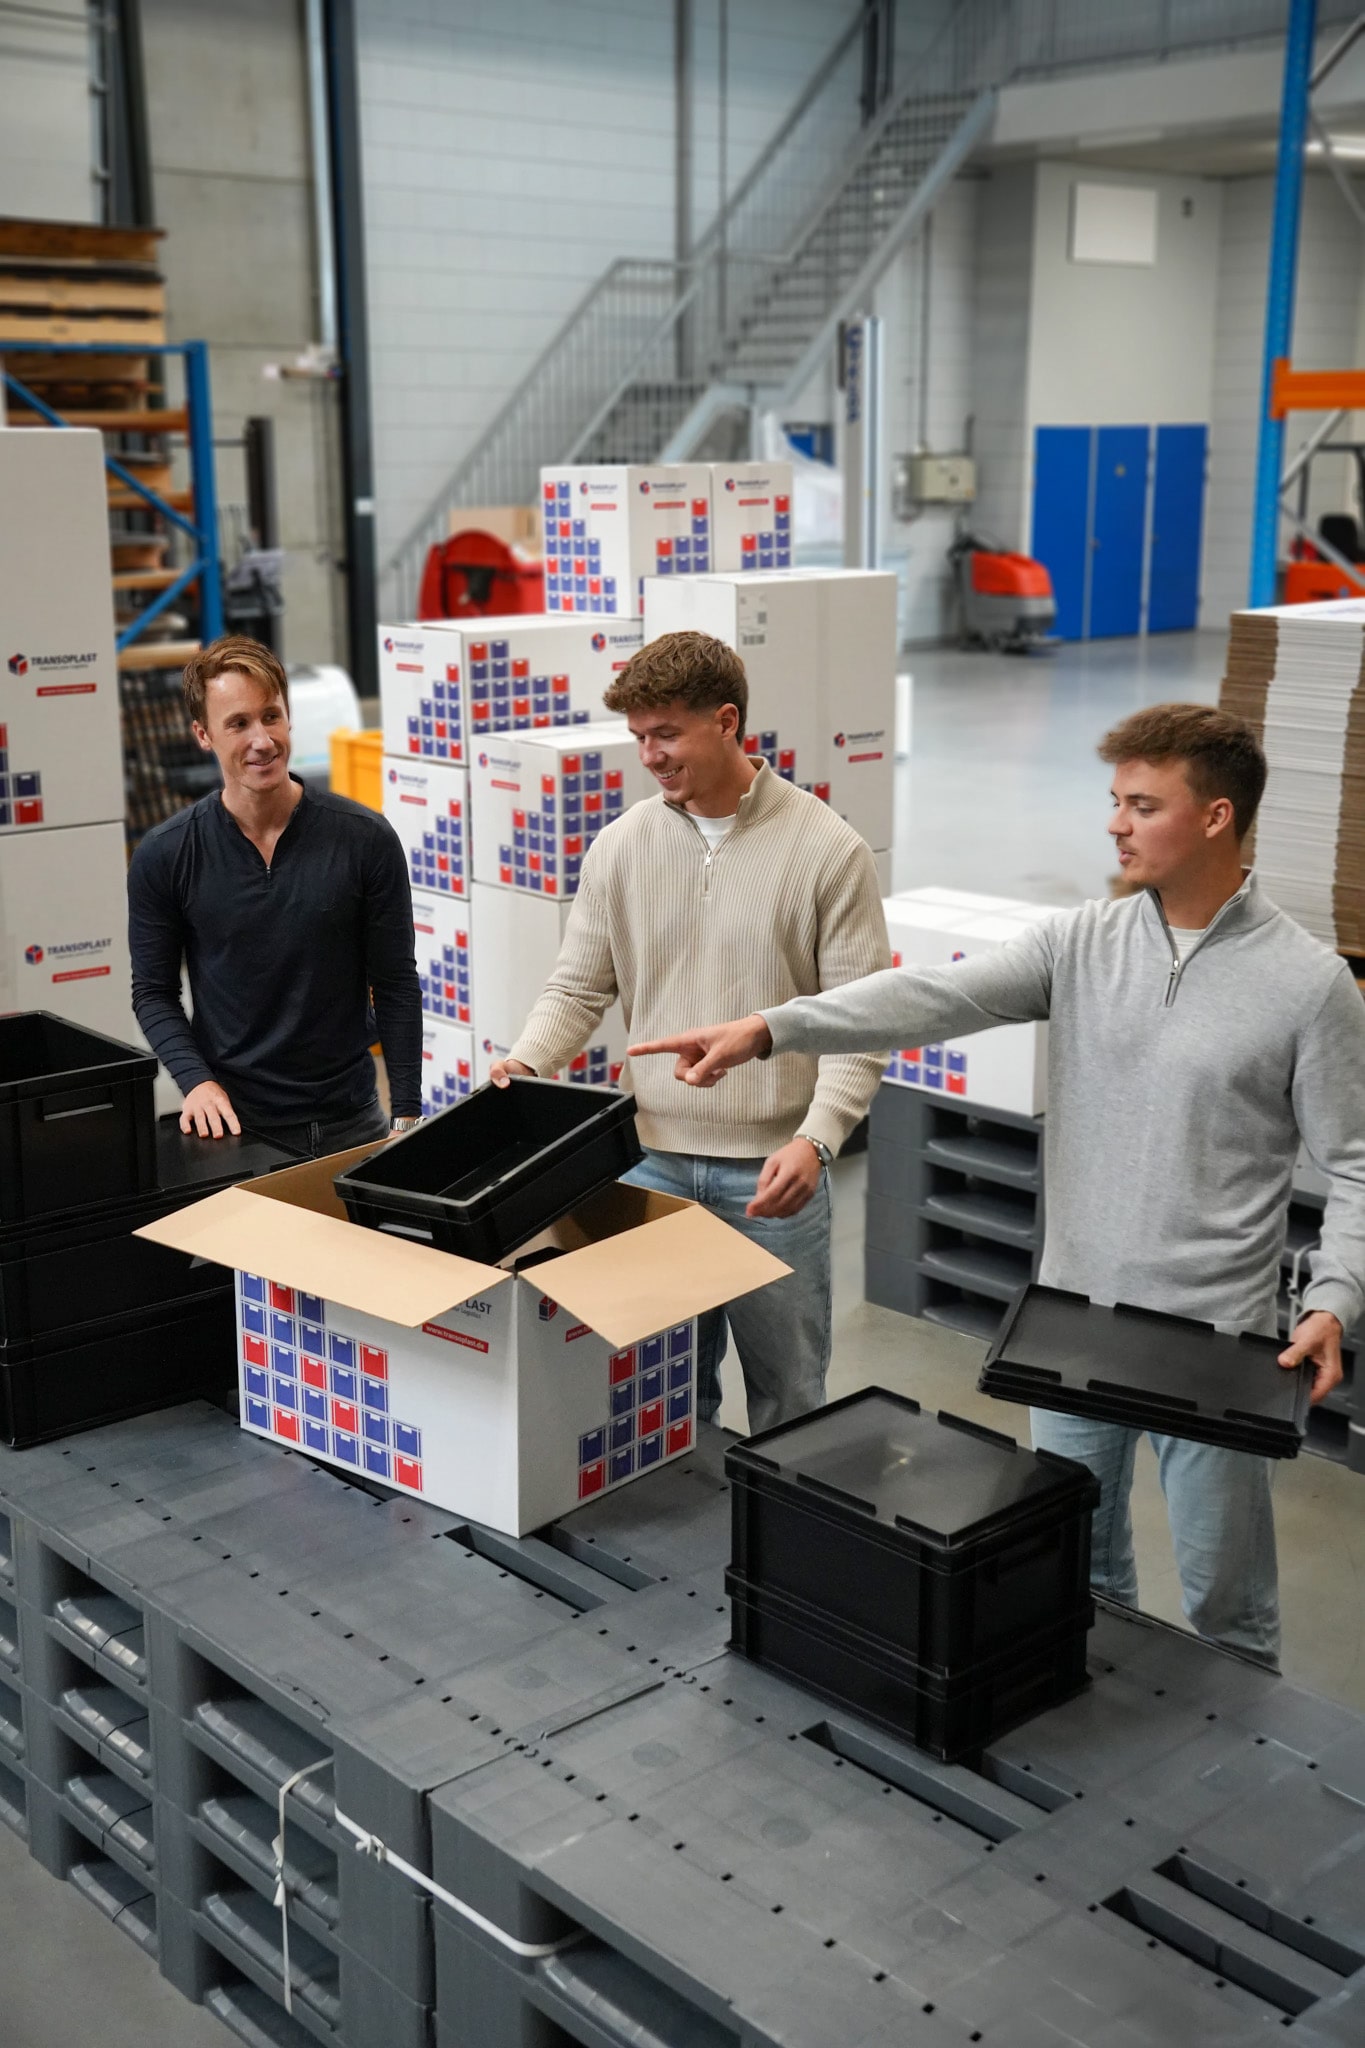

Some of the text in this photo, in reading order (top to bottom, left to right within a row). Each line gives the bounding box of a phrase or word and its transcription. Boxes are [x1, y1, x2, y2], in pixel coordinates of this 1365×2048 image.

[31, 653, 97, 666] TRANSOPLAST
[47, 938, 112, 956] TRANSOPLAST
[465, 1299, 492, 1315] LAST
